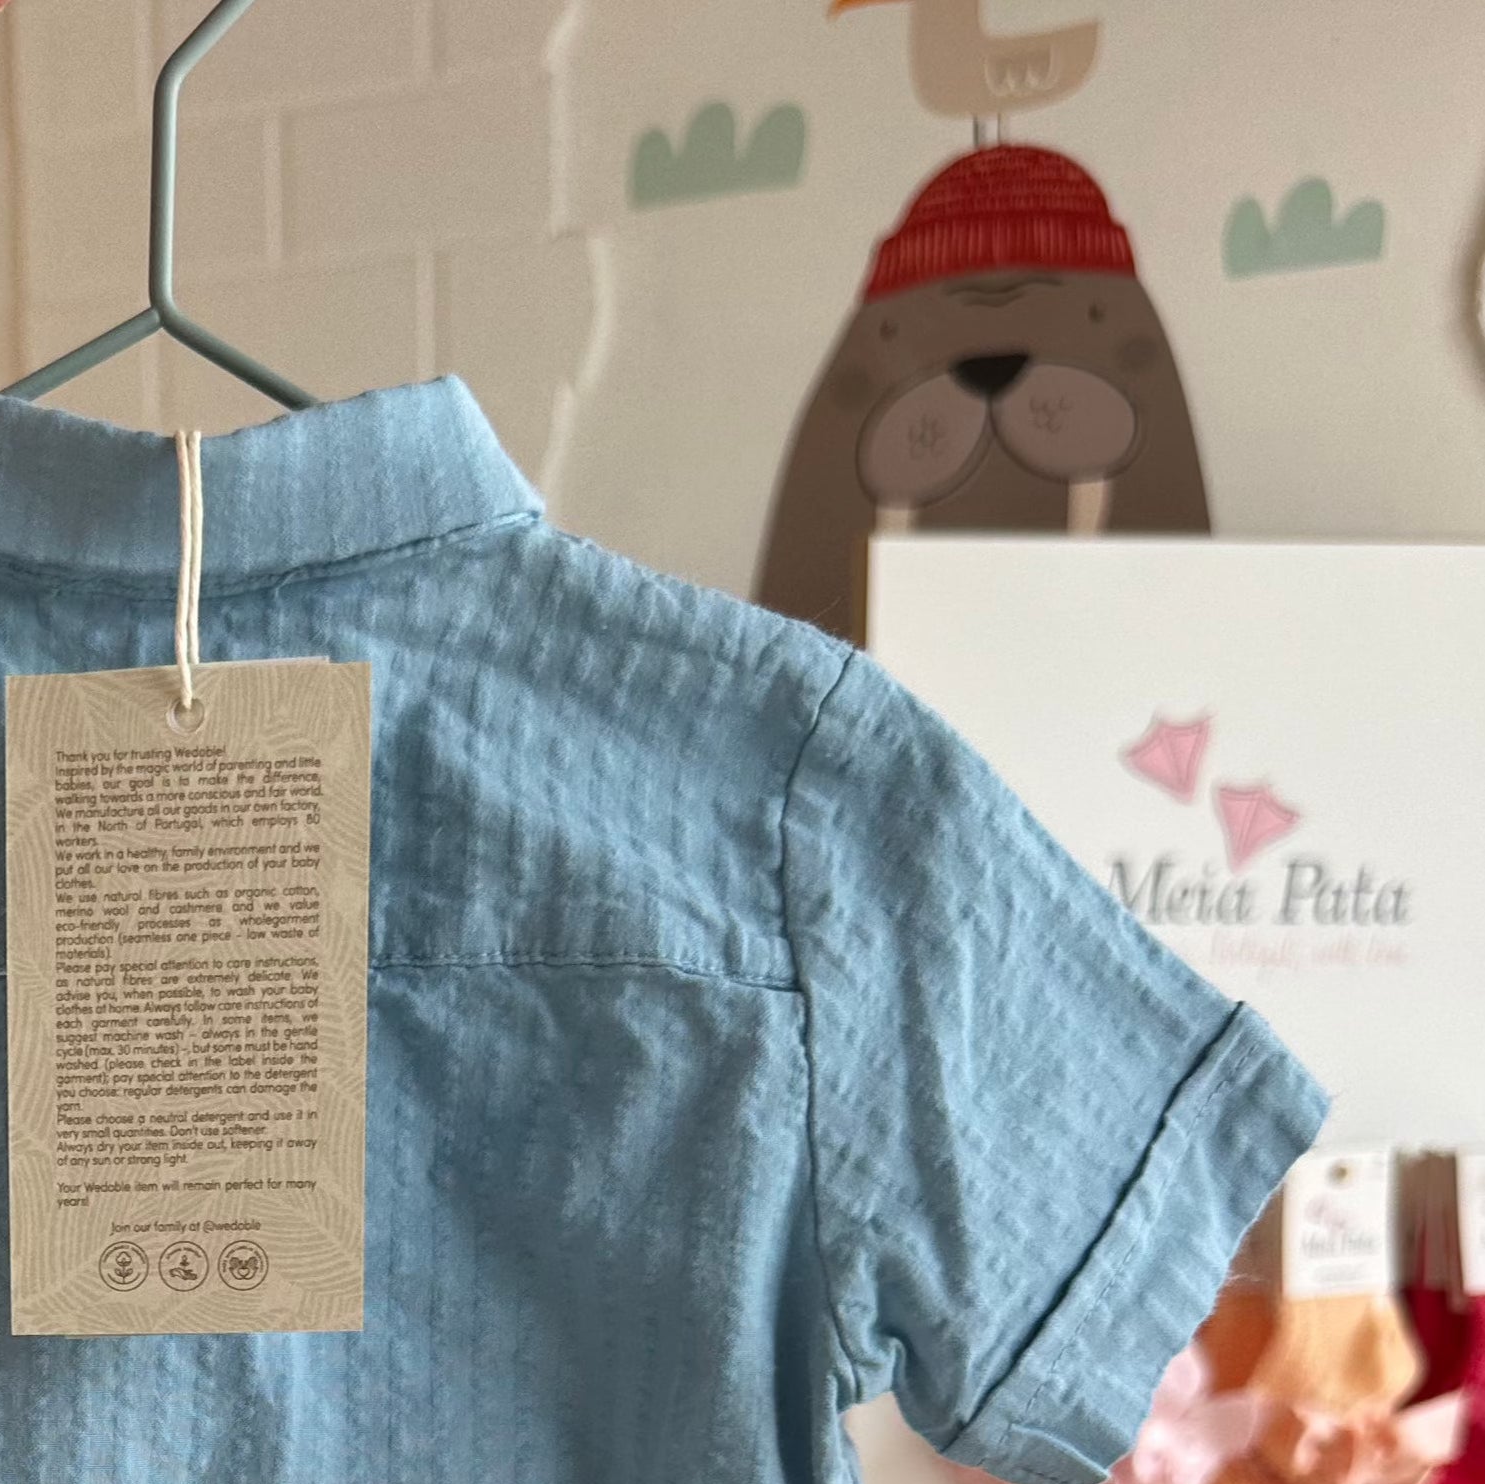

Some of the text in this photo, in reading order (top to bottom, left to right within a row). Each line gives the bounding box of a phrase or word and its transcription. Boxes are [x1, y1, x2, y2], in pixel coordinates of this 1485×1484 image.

[55, 750, 87, 761] Thank
[91, 752, 109, 763] you
[113, 749, 127, 759] for
[130, 747, 172, 761] trusting
[54, 756, 321, 778] Inspired the magic world parenting and little
[103, 780, 120, 788] our
[129, 776, 154, 790] goal
[198, 774, 228, 784] make
[236, 773, 254, 783] the
[55, 793, 96, 807] walking
[100, 791, 142, 802] towards
[156, 792, 185, 800] more
[189, 788, 240, 799] conscious
[243, 787, 265, 797] and
[269, 786, 285, 796] fair
[55, 808, 72, 818] We
[75, 805, 144, 817] manufacture
[162, 806, 180, 814] our
[183, 803, 217, 816] goods
[233, 804, 250, 812] our
[253, 803, 276, 811] own
[73, 821, 90, 831] the
[98, 820, 127, 831] North
[212, 816, 243, 827] which
[251, 814, 296, 828] employs
[55, 850, 72, 860] We
[75, 849, 100, 860] work
[171, 846, 204, 859] family
[279, 842, 300, 853] and
[94, 856, 320, 873] our love the production your baby
[55, 892, 72, 902] We
[79, 894, 96, 902] use
[148, 889, 178, 899] fibres
[184, 888, 209, 898] such
[234, 886, 275, 899] organic
[1106, 856, 1412, 925] Meia Pata
[103, 905, 128, 915] wool
[138, 904, 160, 914] and
[169, 902, 222, 913] cashmere
[232, 901, 253, 911] and
[289, 898, 319, 909] value
[55, 913, 319, 933] eco-friendly processes wholegarment
[55, 928, 303, 947] production (seamless one piece low waste
[55, 958, 251, 974] Please pay special attention care
[122, 974, 152, 984] fibres
[186, 971, 239, 985] extremely
[55, 983, 318, 1000] advise when wash your baby
[55, 997, 304, 1014] clothes Always follow care instructions
[55, 1015, 251, 1030] each garment some
[55, 1025, 317, 1045] suggest machine wash always the gentle
[55, 1045, 83, 1058] cycle
[192, 1042, 210, 1052] but
[212, 1043, 242, 1051] some
[244, 1041, 270, 1050] must
[290, 1039, 318, 1049] hand
[56, 1053, 293, 1071] washed (please check label inside
[112, 1067, 317, 1084] pay special attention detergent
[56, 1089, 75, 1100] you
[123, 1085, 161, 1098] regular
[165, 1083, 222, 1097] detergents
[249, 1081, 296, 1095] damage
[57, 1110, 293, 1124] Please choose neutral detergent use
[56, 1125, 197, 1141] very small Don't
[56, 1137, 316, 1155] Always dry your item inside keeping away
[70, 1154, 160, 1168] any sun strong
[58, 1182, 80, 1192] Your
[134, 1181, 157, 1191] item
[162, 1180, 179, 1190] will
[183, 1179, 220, 1189] remain
[225, 1178, 263, 1191] perfect
[267, 1178, 281, 1187] for
[286, 1179, 316, 1190] many
[110, 1222, 131, 1234] Join
[153, 1221, 186, 1233] family
